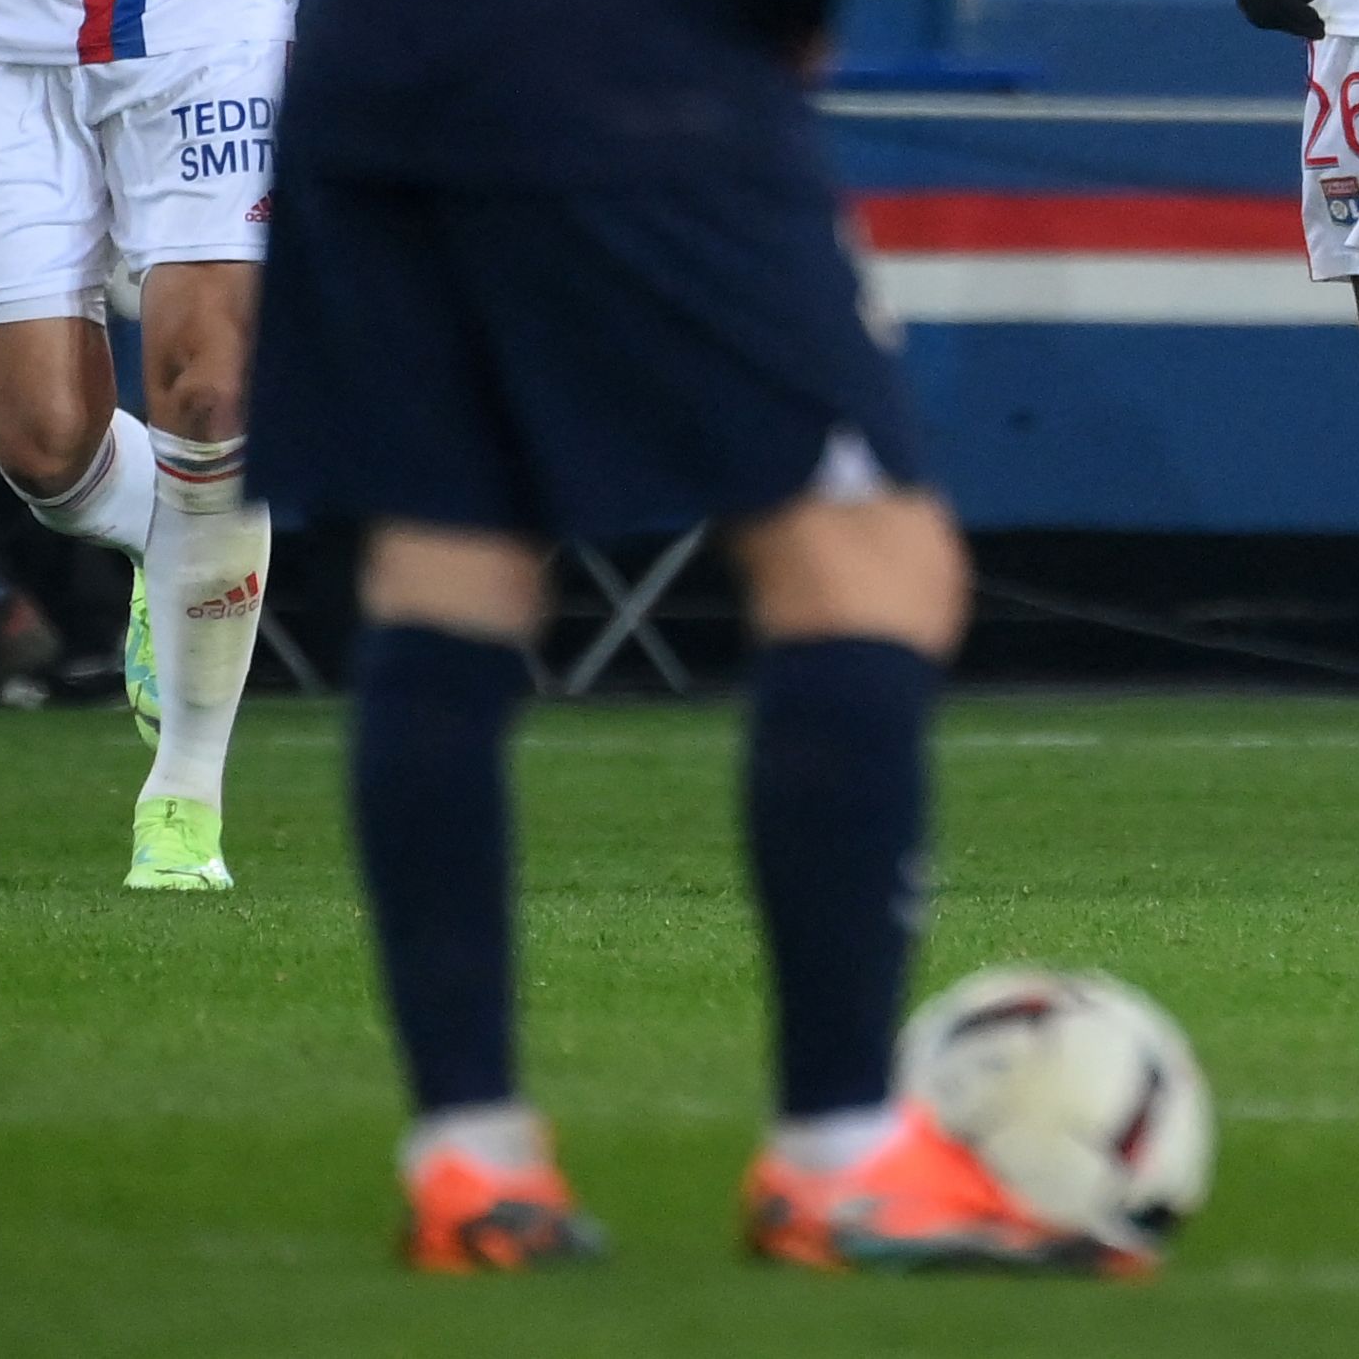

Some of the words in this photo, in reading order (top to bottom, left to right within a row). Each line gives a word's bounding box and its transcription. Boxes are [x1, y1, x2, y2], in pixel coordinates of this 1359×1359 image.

[170, 97, 278, 139] TEDD
[180, 139, 276, 181] SMIT
[186, 598, 260, 620] adida
